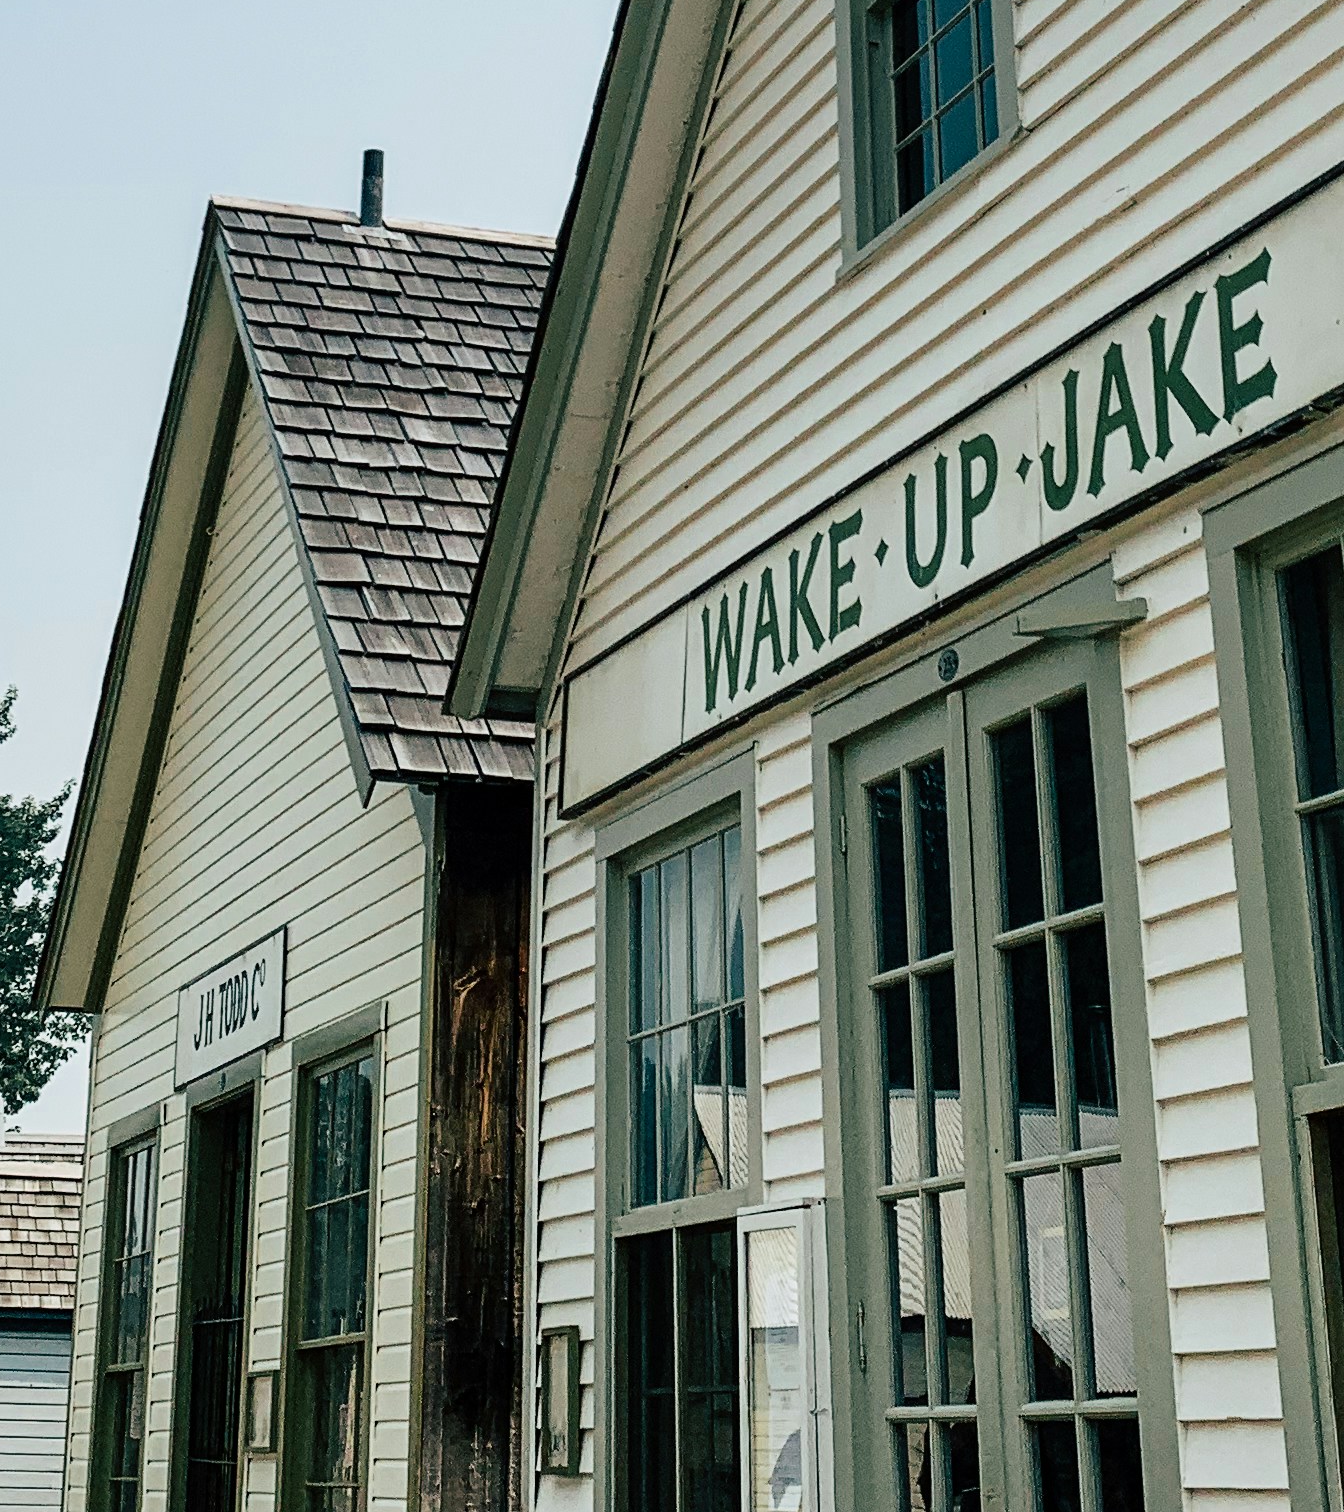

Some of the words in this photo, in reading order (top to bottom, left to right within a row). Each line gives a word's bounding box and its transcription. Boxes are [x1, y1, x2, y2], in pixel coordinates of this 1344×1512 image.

[702, 509, 863, 714] WAKE
[903, 433, 998, 588] UP
[1040, 247, 1278, 511] JAKE
[219, 970, 249, 1039] TODD
